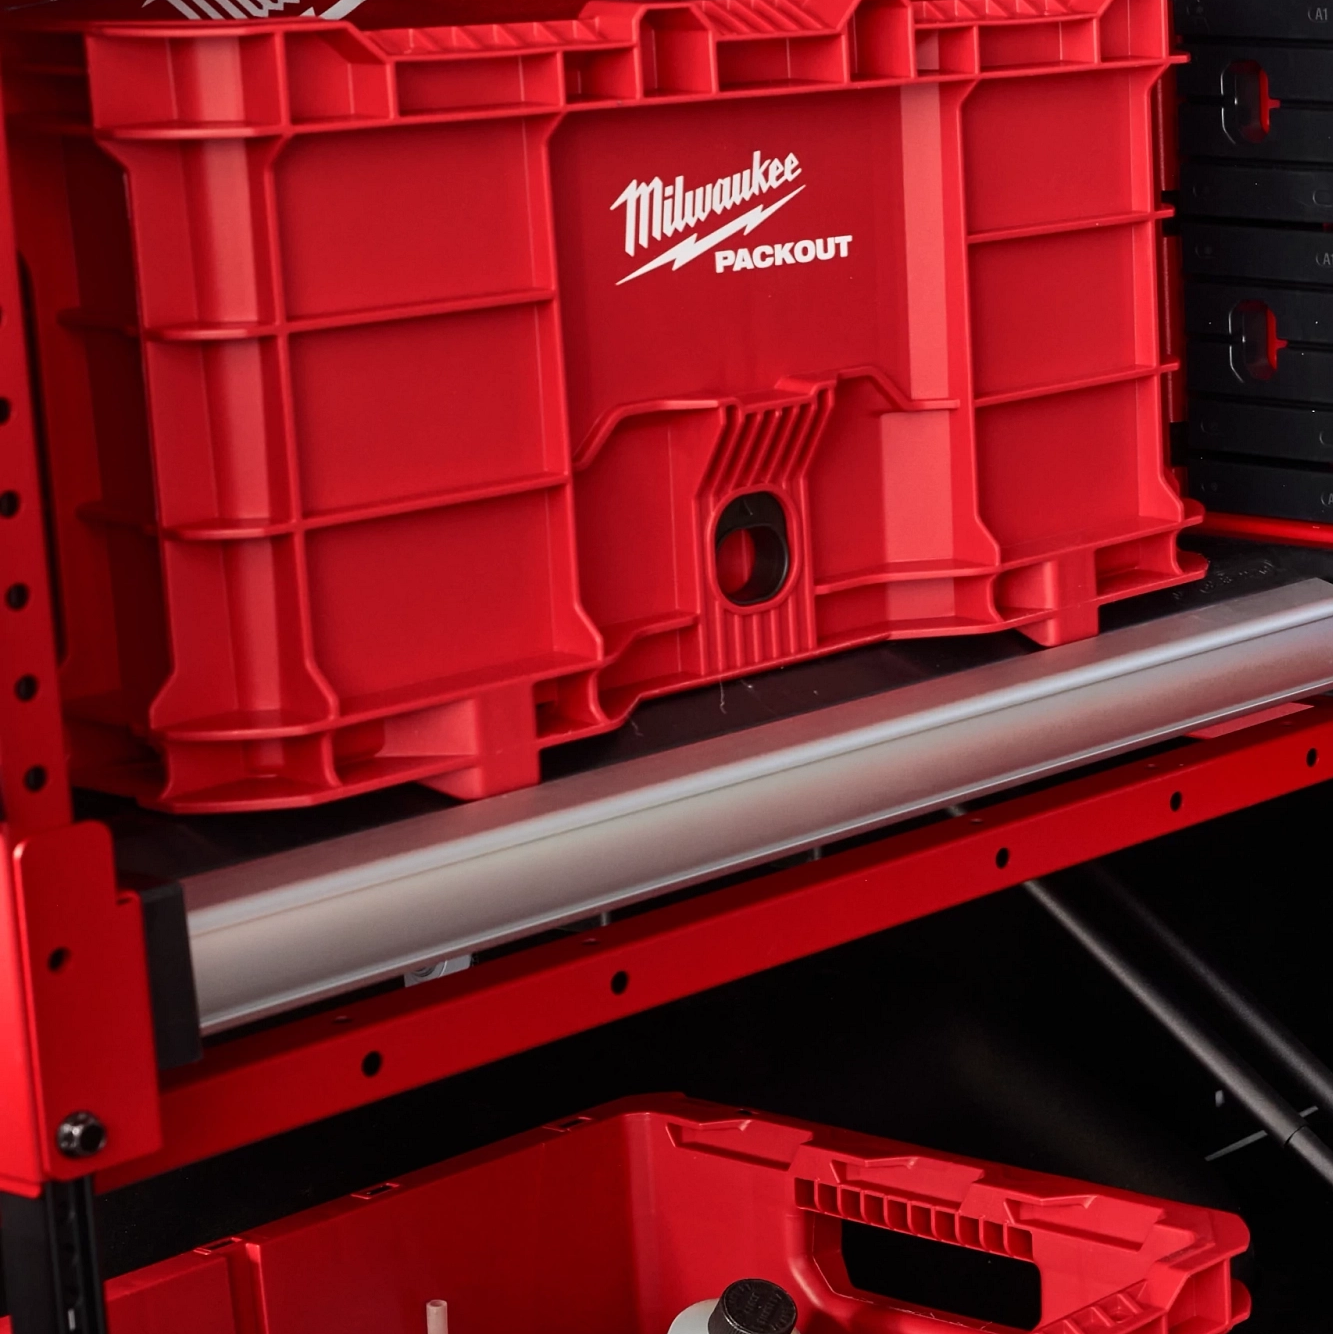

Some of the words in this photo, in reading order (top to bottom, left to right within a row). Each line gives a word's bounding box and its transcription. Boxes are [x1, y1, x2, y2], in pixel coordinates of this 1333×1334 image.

[1314, 7, 1328, 21] A1
[609, 151, 803, 257] Milwaukee
[714, 234, 853, 274] PACKOUT
